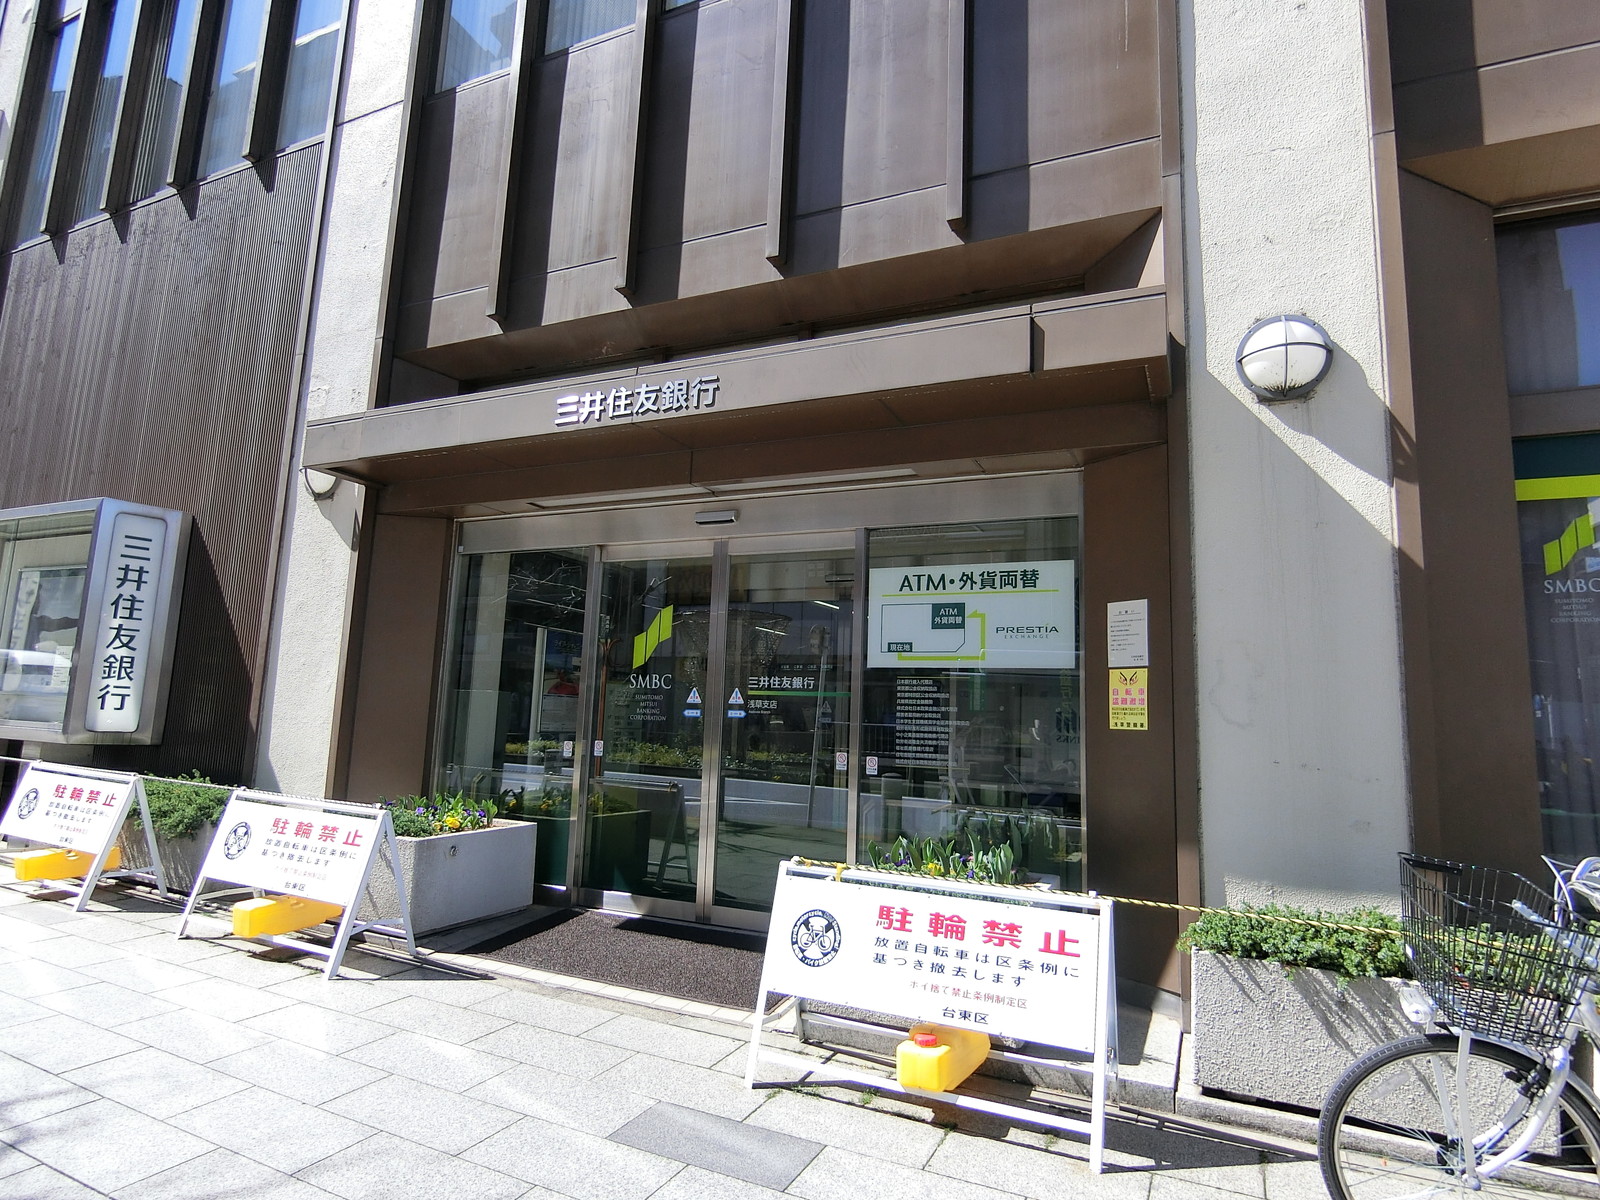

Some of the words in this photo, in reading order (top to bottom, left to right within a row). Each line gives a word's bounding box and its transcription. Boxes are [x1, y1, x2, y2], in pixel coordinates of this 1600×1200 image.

[555, 375, 720, 426] 三井住友銀行
[899, 568, 1040, 592] ATM・外貨両替
[939, 608, 958, 616] ATM
[97, 534, 153, 711] 三井住友銀行
[934, 616, 963, 625] 外貨両替
[996, 624, 1059, 634] PRESTIA
[889, 643, 911, 651] 現在地
[629, 673, 672, 689] SMBC
[748, 676, 815, 690] 三井住友銀行
[747, 700, 778, 709] 浅草支店
[630, 714, 667, 722] CORPORATION
[53, 784, 118, 807] 駐輪禁止
[269, 817, 363, 847] 駐輪禁止
[285, 881, 307, 892] 台東区
[876, 905, 1081, 958] 駐輪禁止
[874, 936, 1080, 978] 放置自転車は区条例に
[942, 1006, 990, 1025] 台東区
